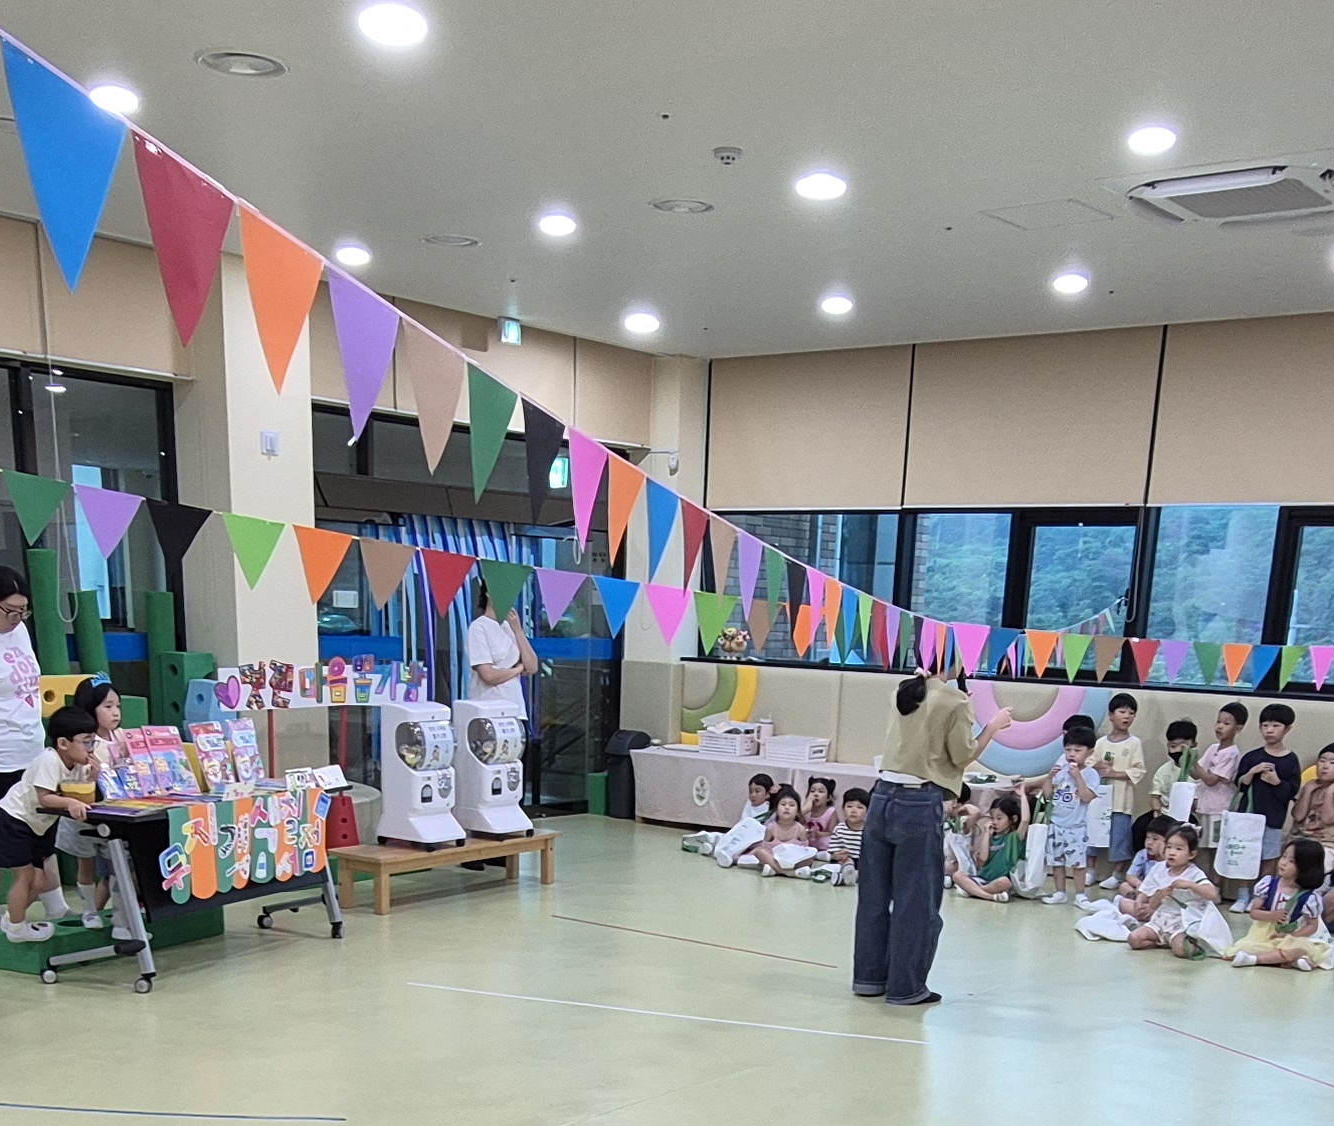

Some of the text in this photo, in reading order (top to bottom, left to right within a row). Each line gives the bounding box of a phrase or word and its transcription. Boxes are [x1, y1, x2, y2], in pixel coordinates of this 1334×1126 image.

[298, 656, 349, 704] 마음
[351, 653, 428, 703] 뽑기방
[158, 802, 250, 891] 무지개
